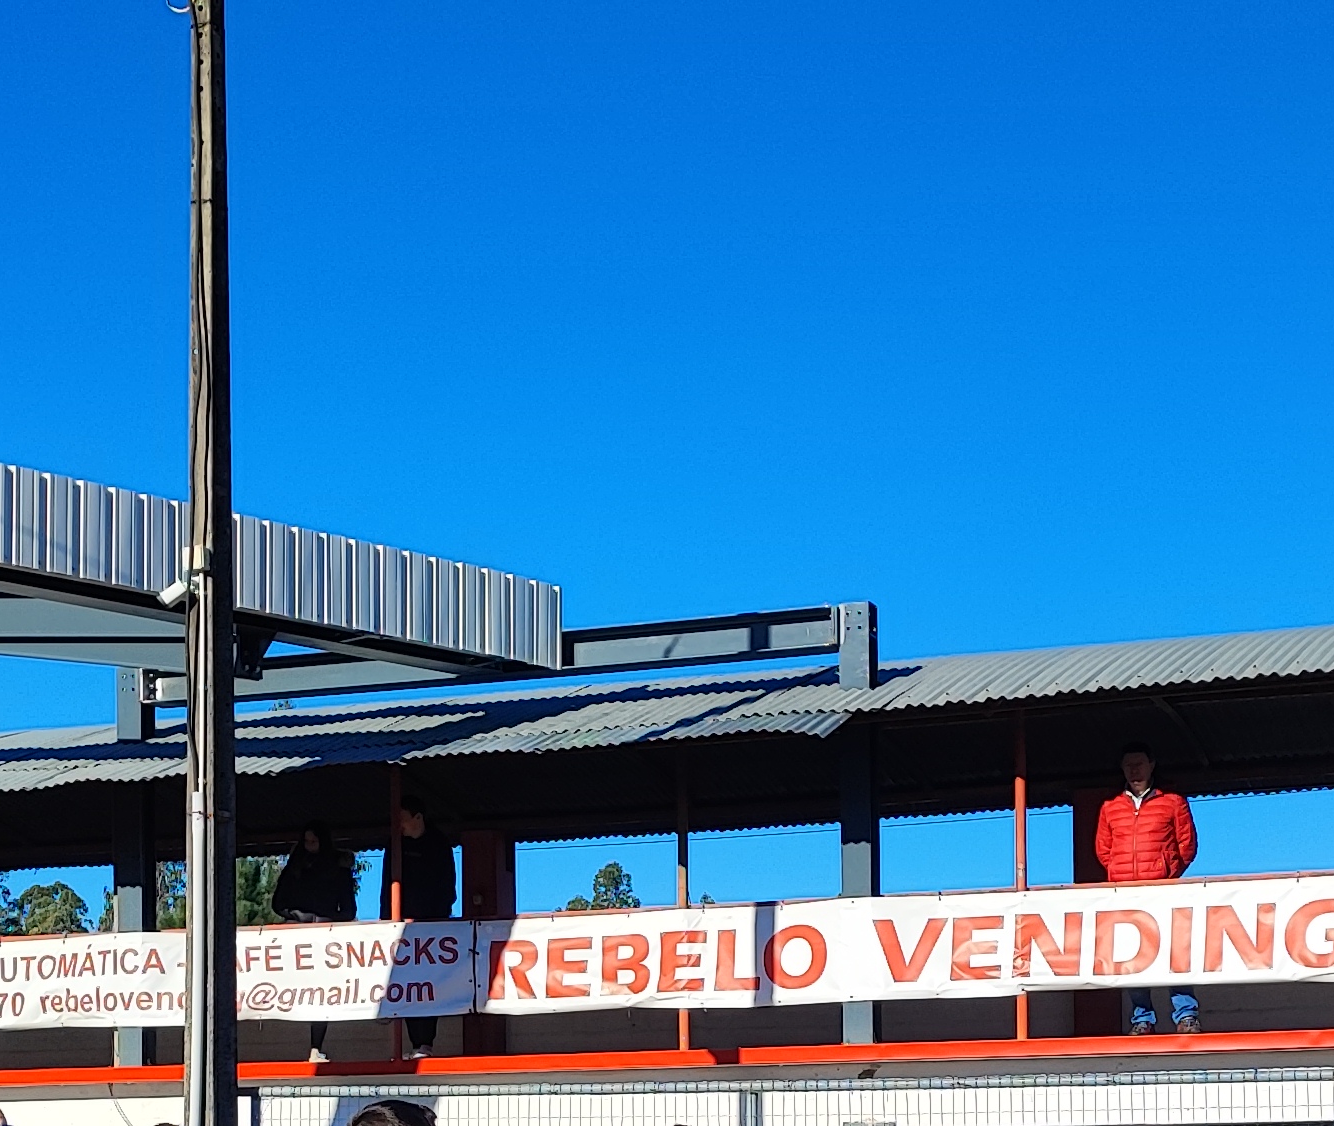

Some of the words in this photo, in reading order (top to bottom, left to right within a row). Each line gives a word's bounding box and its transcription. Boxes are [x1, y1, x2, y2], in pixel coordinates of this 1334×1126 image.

[236, 937, 284, 973] FÉ
[294, 943, 315, 971] E
[324, 936, 459, 970] SNACKS
[488, 925, 828, 1001] REBELO
